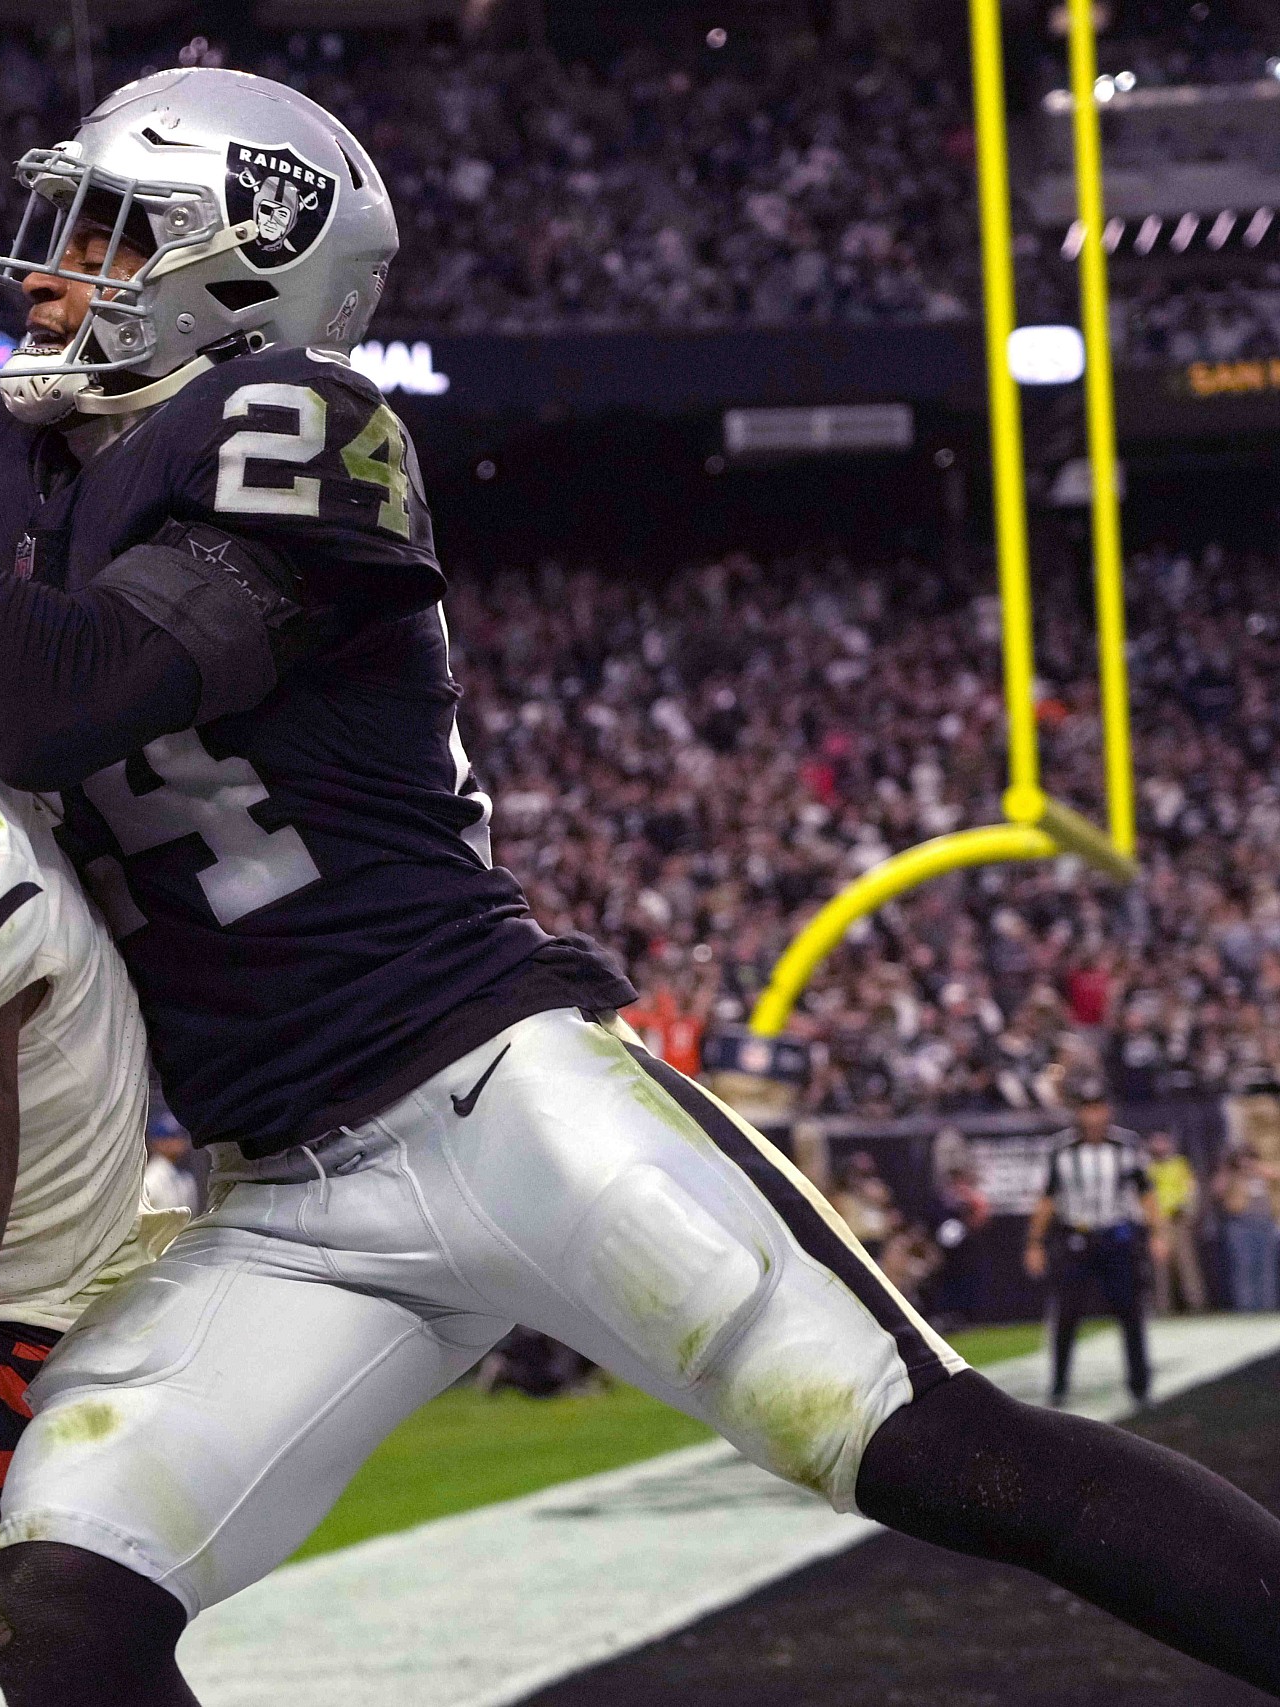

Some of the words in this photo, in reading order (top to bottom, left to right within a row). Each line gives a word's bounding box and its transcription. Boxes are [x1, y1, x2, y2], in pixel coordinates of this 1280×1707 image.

[238, 147, 327, 190] RAIDERS
[349, 340, 451, 396] NAL
[214, 382, 410, 541] 24
[78, 727, 321, 940] 4
